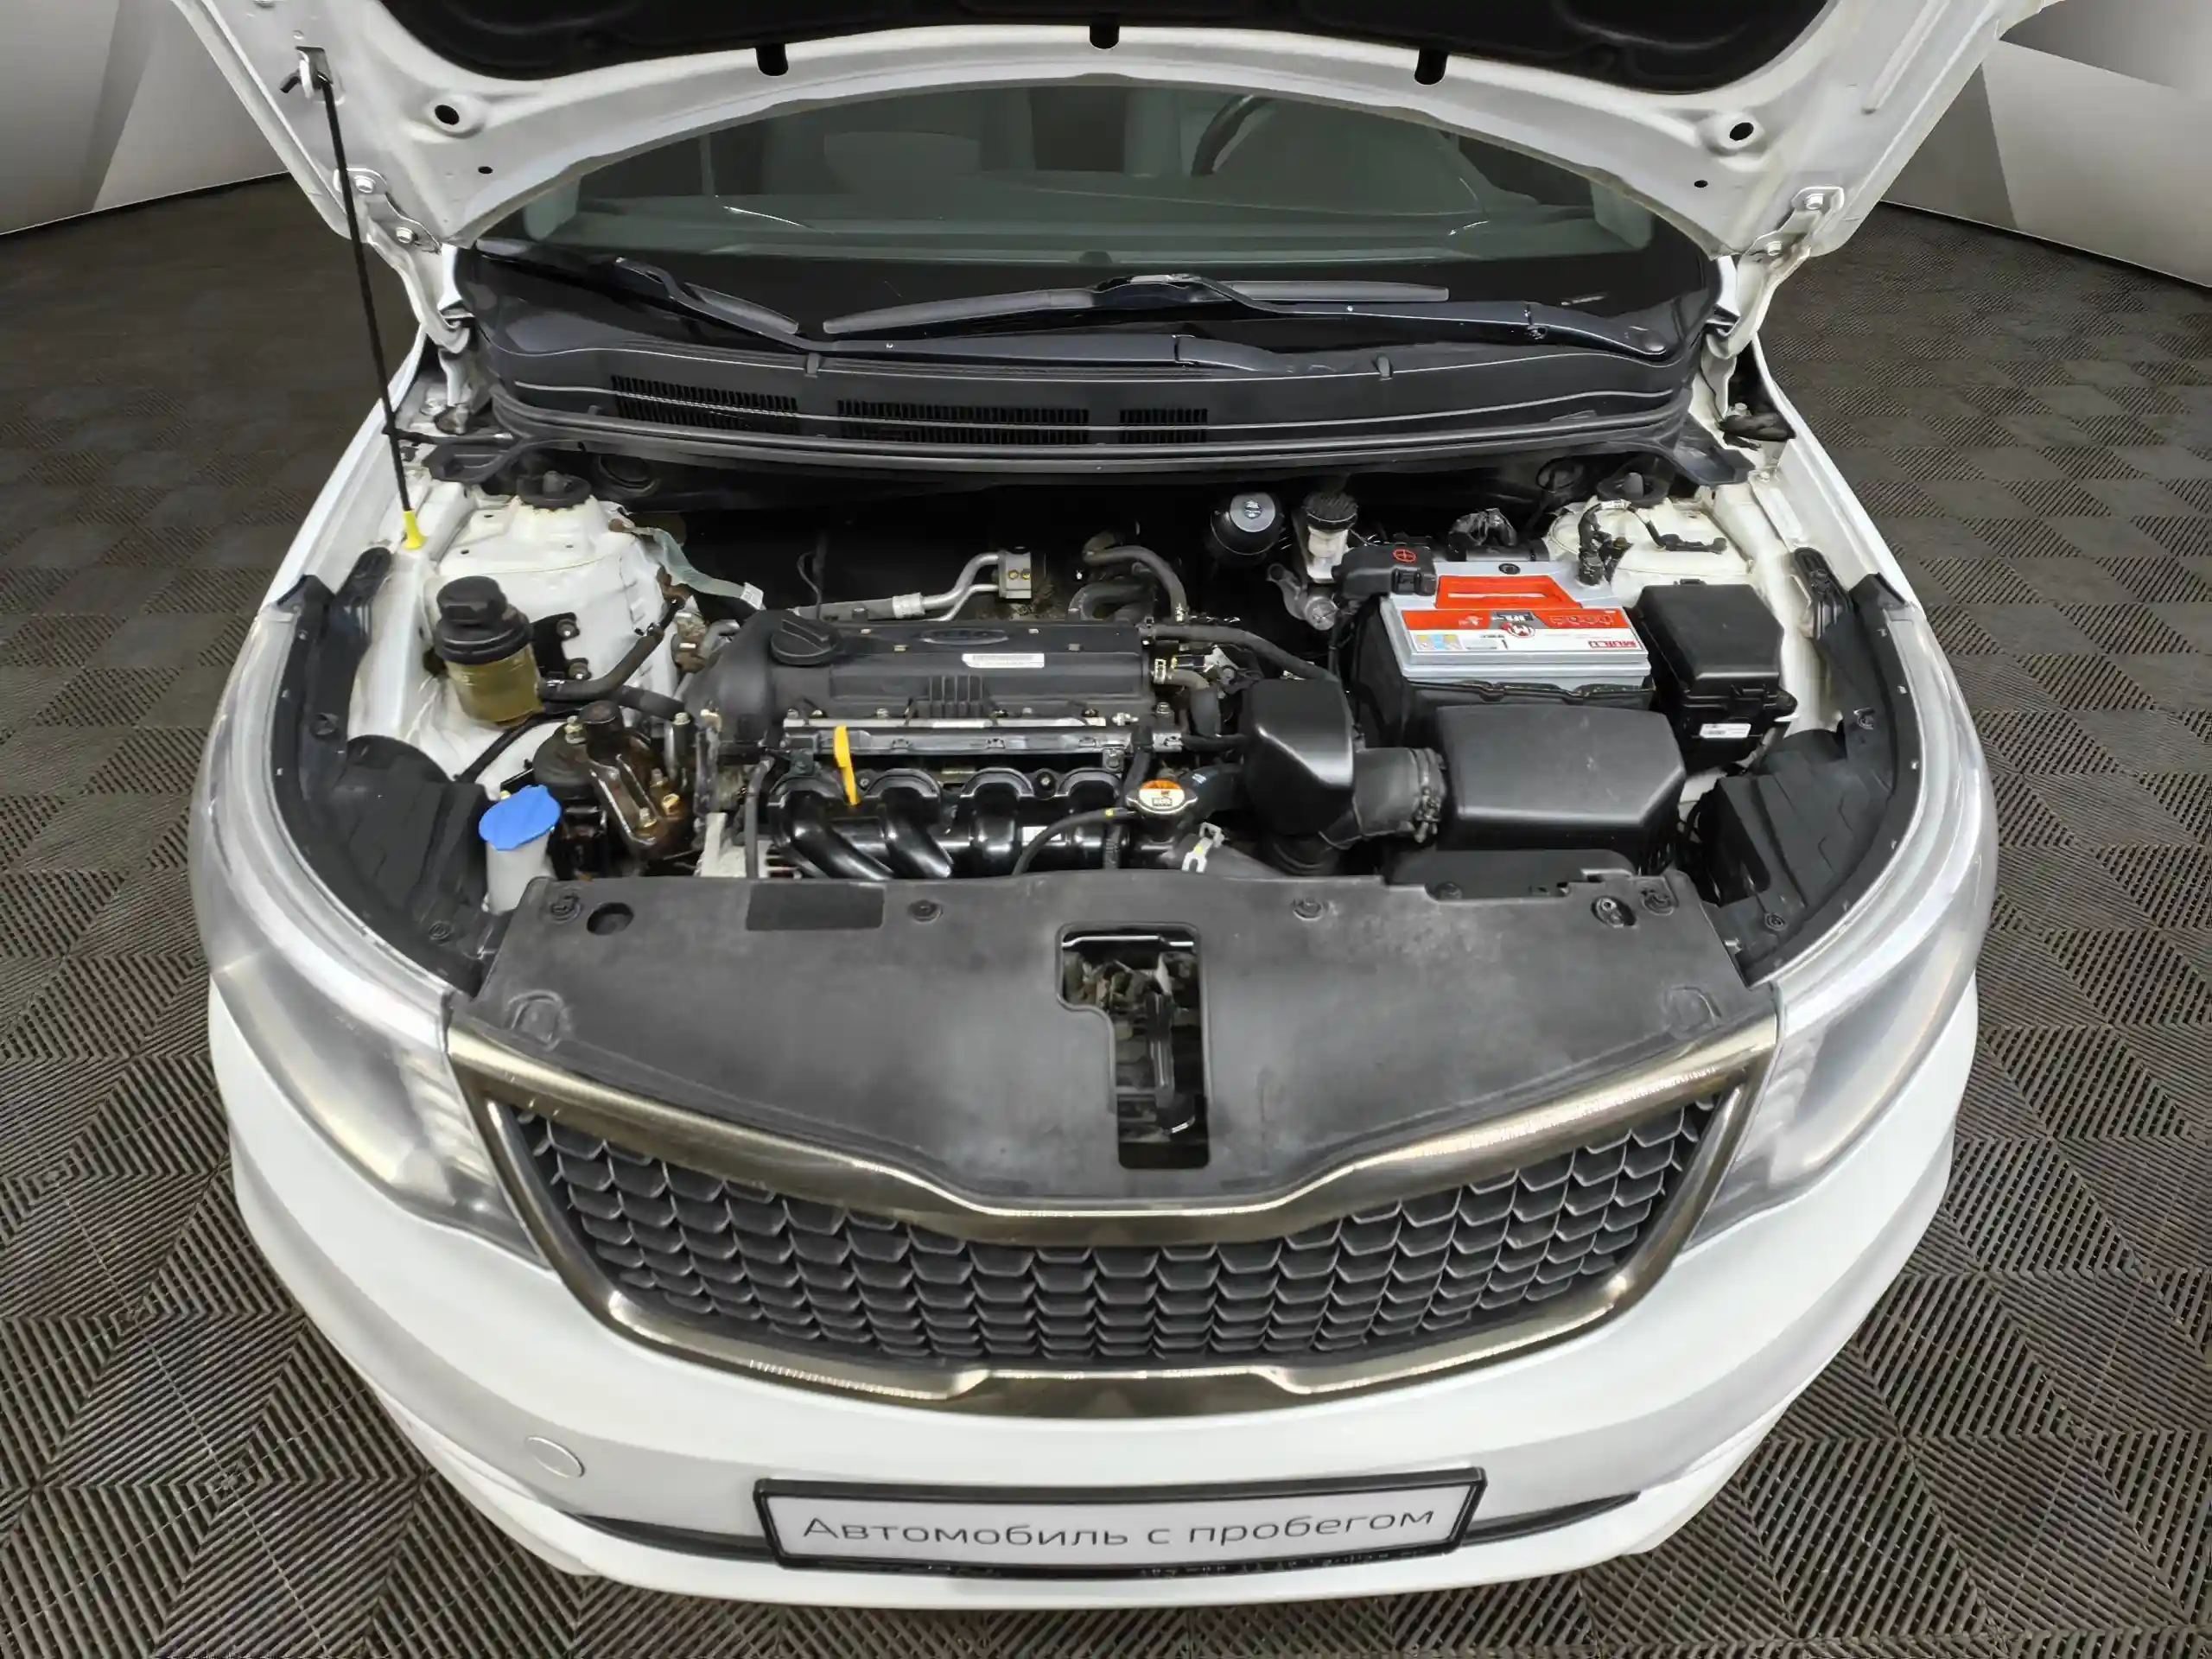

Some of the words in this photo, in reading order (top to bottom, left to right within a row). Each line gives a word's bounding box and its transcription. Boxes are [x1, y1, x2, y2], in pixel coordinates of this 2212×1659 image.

[804, 1516, 1128, 1545] Автомобиль
[1147, 1528, 1170, 1544] с
[1189, 1510, 1434, 1546] пробегом
